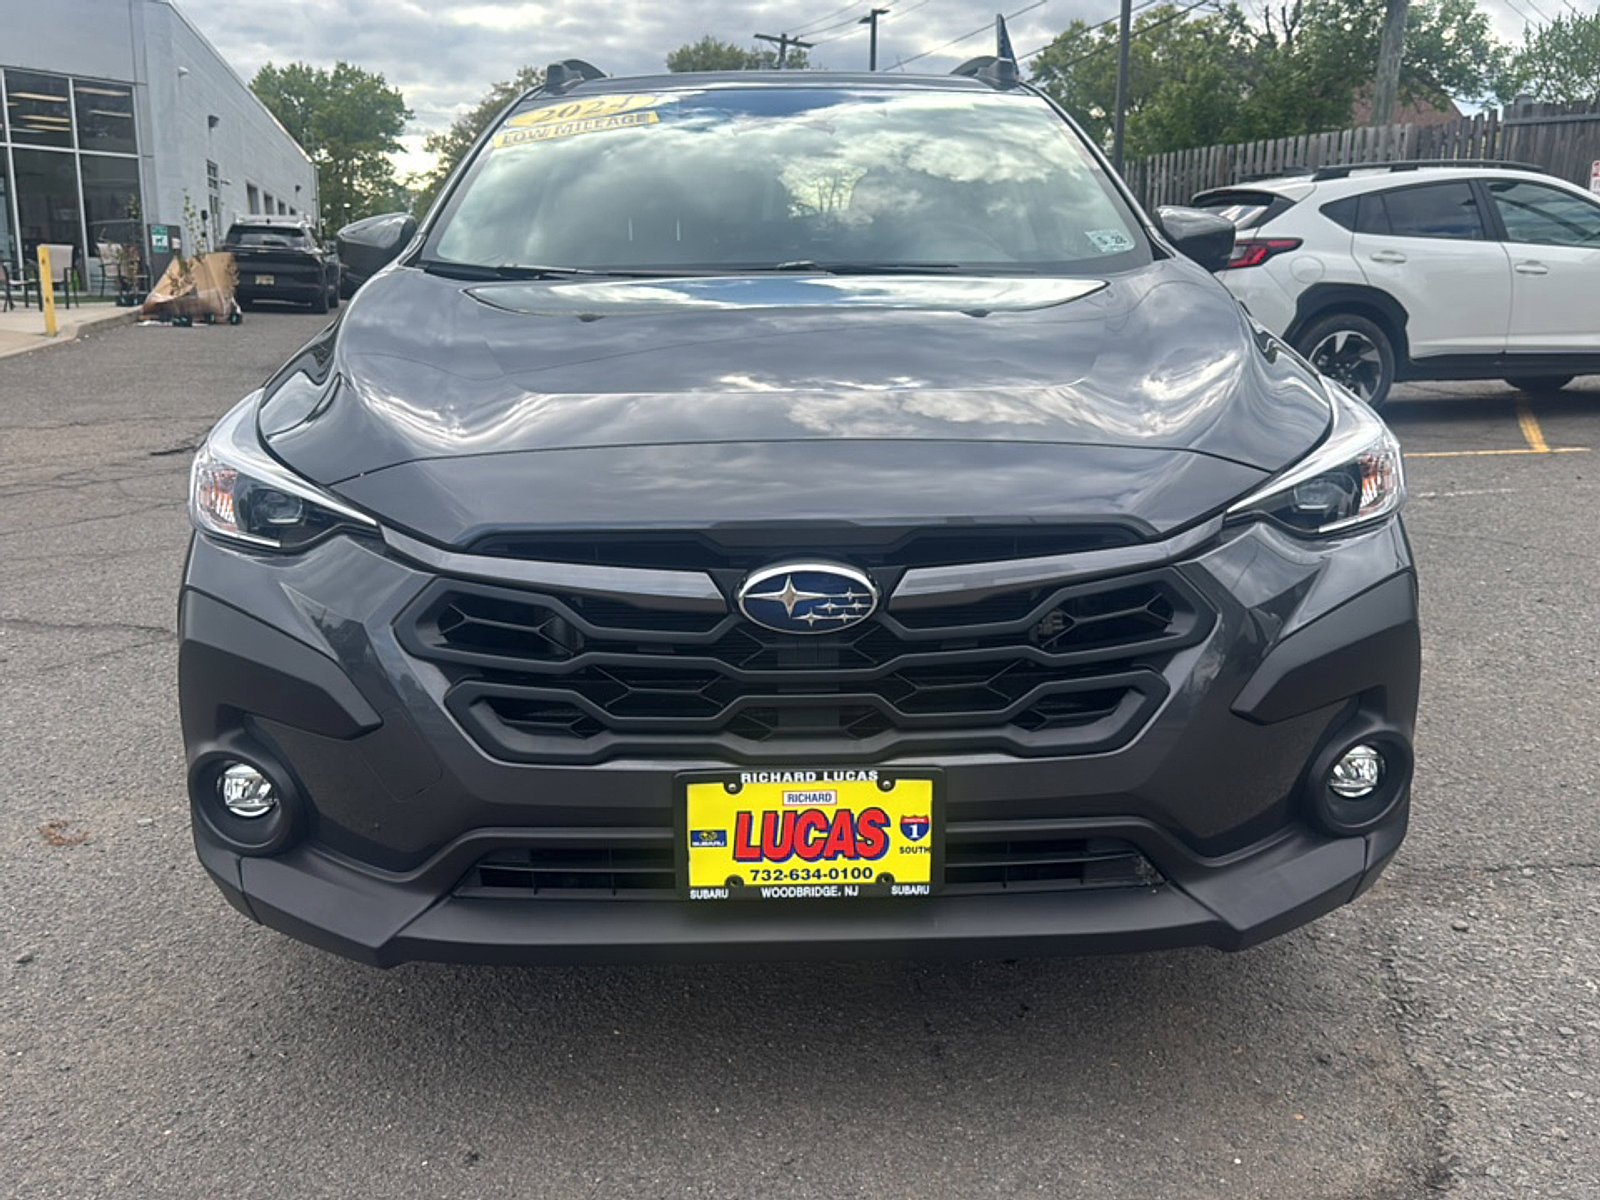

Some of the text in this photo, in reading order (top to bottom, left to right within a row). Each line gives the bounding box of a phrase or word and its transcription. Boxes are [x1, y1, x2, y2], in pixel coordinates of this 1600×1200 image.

[502, 114, 650, 145] LOW MILEAGE
[741, 770, 878, 784] RICHARD LUCAS
[786, 793, 833, 803] RICHARD
[734, 808, 891, 862] LUCAS
[899, 846, 932, 855] SOUTH
[750, 867, 873, 881] 732-634-0100
[689, 888, 729, 900] SUBARU
[844, 885, 859, 897] NJ
[891, 884, 930, 895] SUBARU
